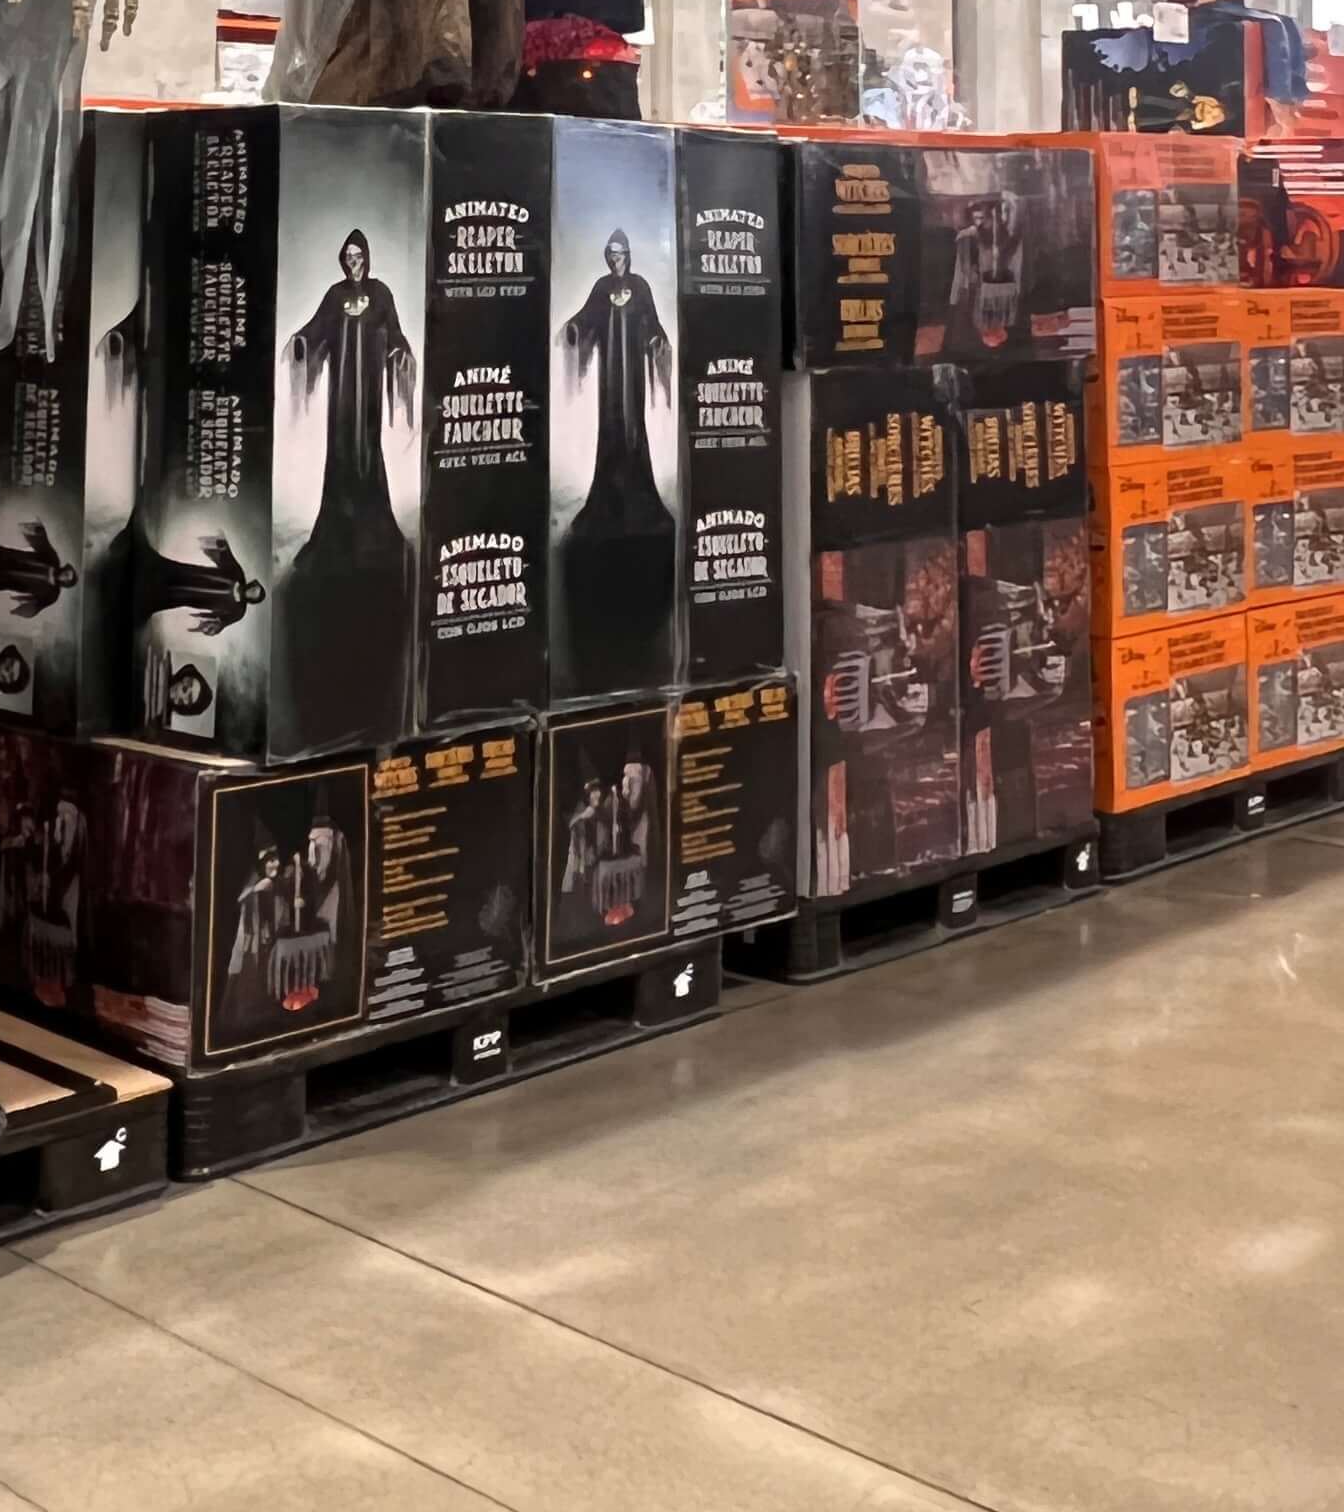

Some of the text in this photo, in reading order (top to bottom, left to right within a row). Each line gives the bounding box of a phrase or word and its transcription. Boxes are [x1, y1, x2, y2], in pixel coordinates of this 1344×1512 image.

[206, 135, 220, 228] SKELETON
[218, 145, 234, 220] REAPER
[233, 129, 248, 234] ANIMATED
[444, 201, 529, 223] ANIMATED
[696, 209, 764, 229] ANIMATED
[456, 226, 516, 250] REAPER
[447, 252, 524, 274] SKELETON
[700, 254, 762, 274] SKELETON
[219, 262, 233, 363] SQUELETTE
[453, 365, 511, 388] ANIMÉ
[442, 391, 523, 418] SQUELETTE
[443, 417, 525, 444] FAUCHEUR
[228, 395, 243, 498] ANIMADO
[696, 510, 765, 533] ANIMADO
[440, 533, 524, 562] ANIMADO
[442, 557, 522, 587] ESQUELETO
[437, 582, 527, 615] DE SEGADOR
[502, 616, 526, 630] LCD
